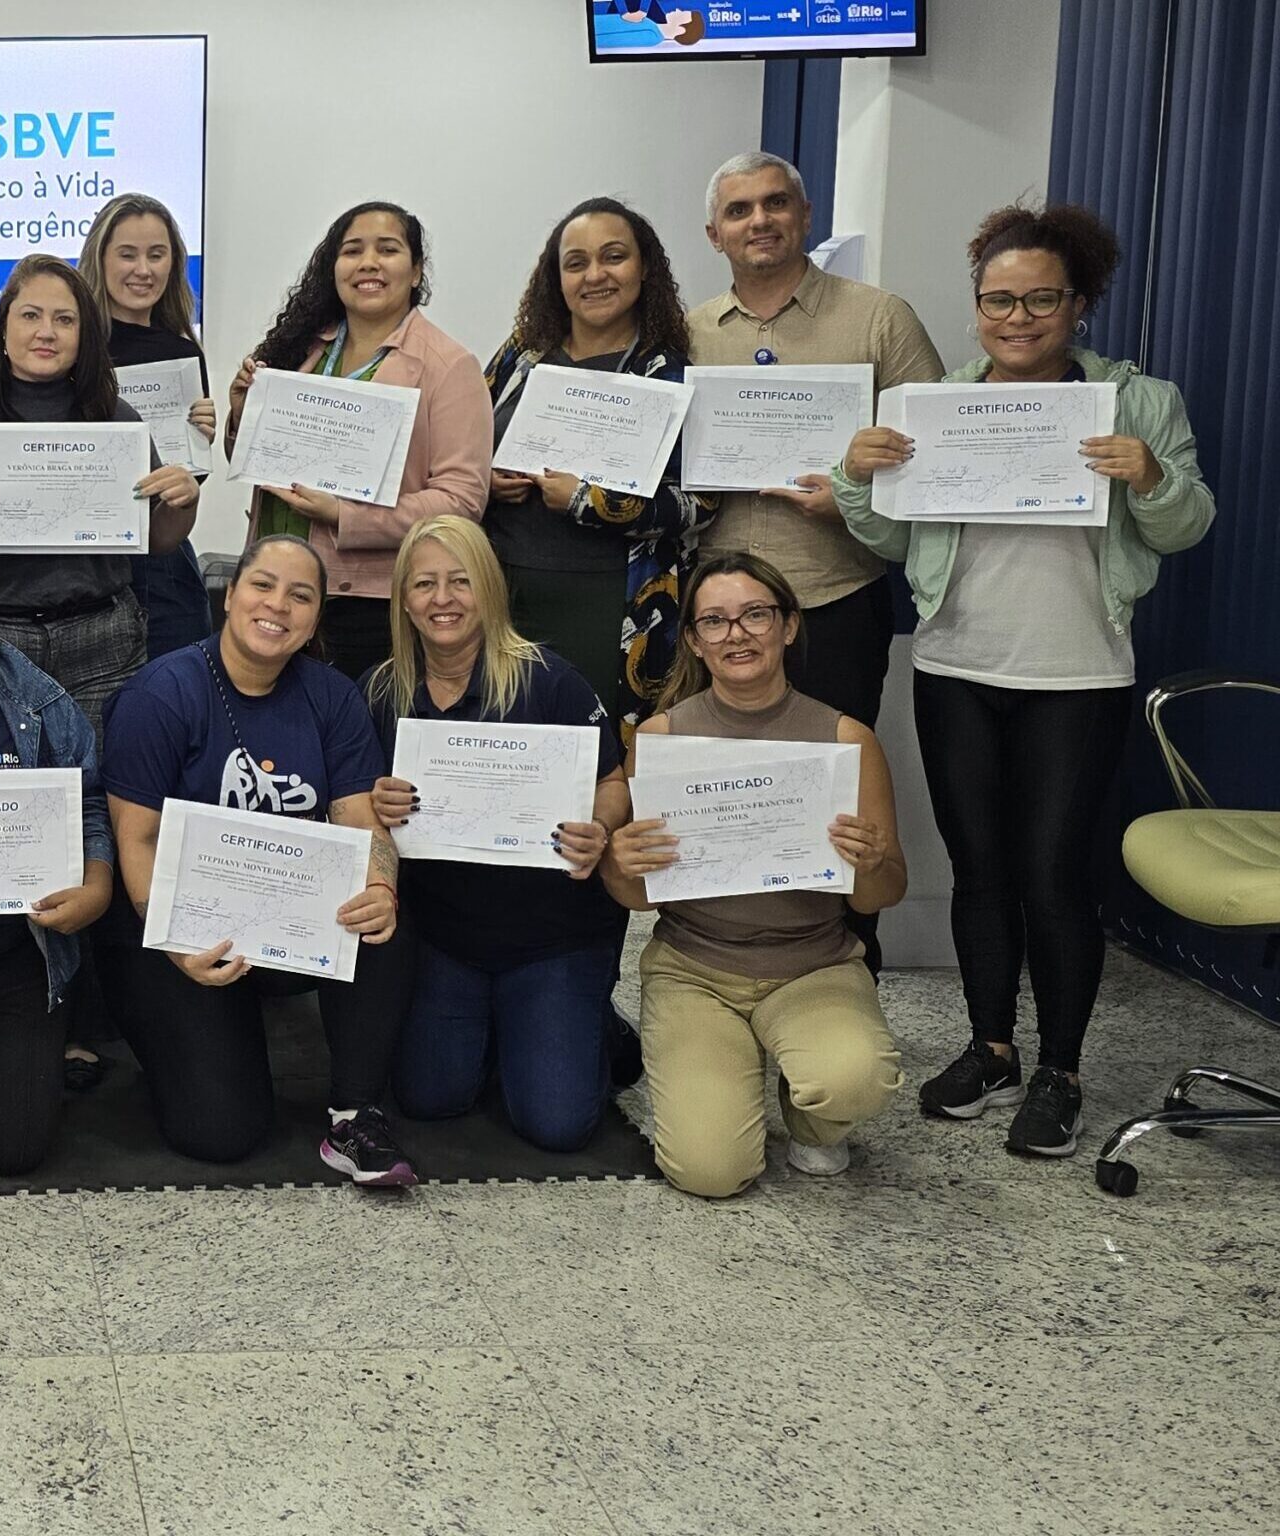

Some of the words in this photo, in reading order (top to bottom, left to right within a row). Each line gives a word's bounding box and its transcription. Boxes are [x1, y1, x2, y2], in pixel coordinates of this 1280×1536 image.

[815, 14, 841, 23] otics
[33, 171, 47, 198] à
[56, 171, 115, 199] Vida
[565, 387, 631, 406] CERTIFICADO
[738, 390, 813, 402] CERTIFICADO
[297, 392, 362, 414] CERTIFICADO
[958, 402, 1042, 415] CERTIFICADO
[23, 443, 96, 452] CERTIFICADO
[1024, 498, 1041, 507] RIO
[81, 533, 97, 541] RIO
[448, 736, 527, 751] CERTIFICADO
[685, 776, 773, 795] CERTIFICADO
[220, 833, 303, 858] CERTIFICADO
[502, 838, 519, 846] RIO
[198, 853, 240, 868] STEPHANY
[243, 862, 288, 877] MONTEIRO
[772, 875, 790, 886] RIO
[7, 901, 24, 909] RIO
[270, 948, 287, 959] RIO
